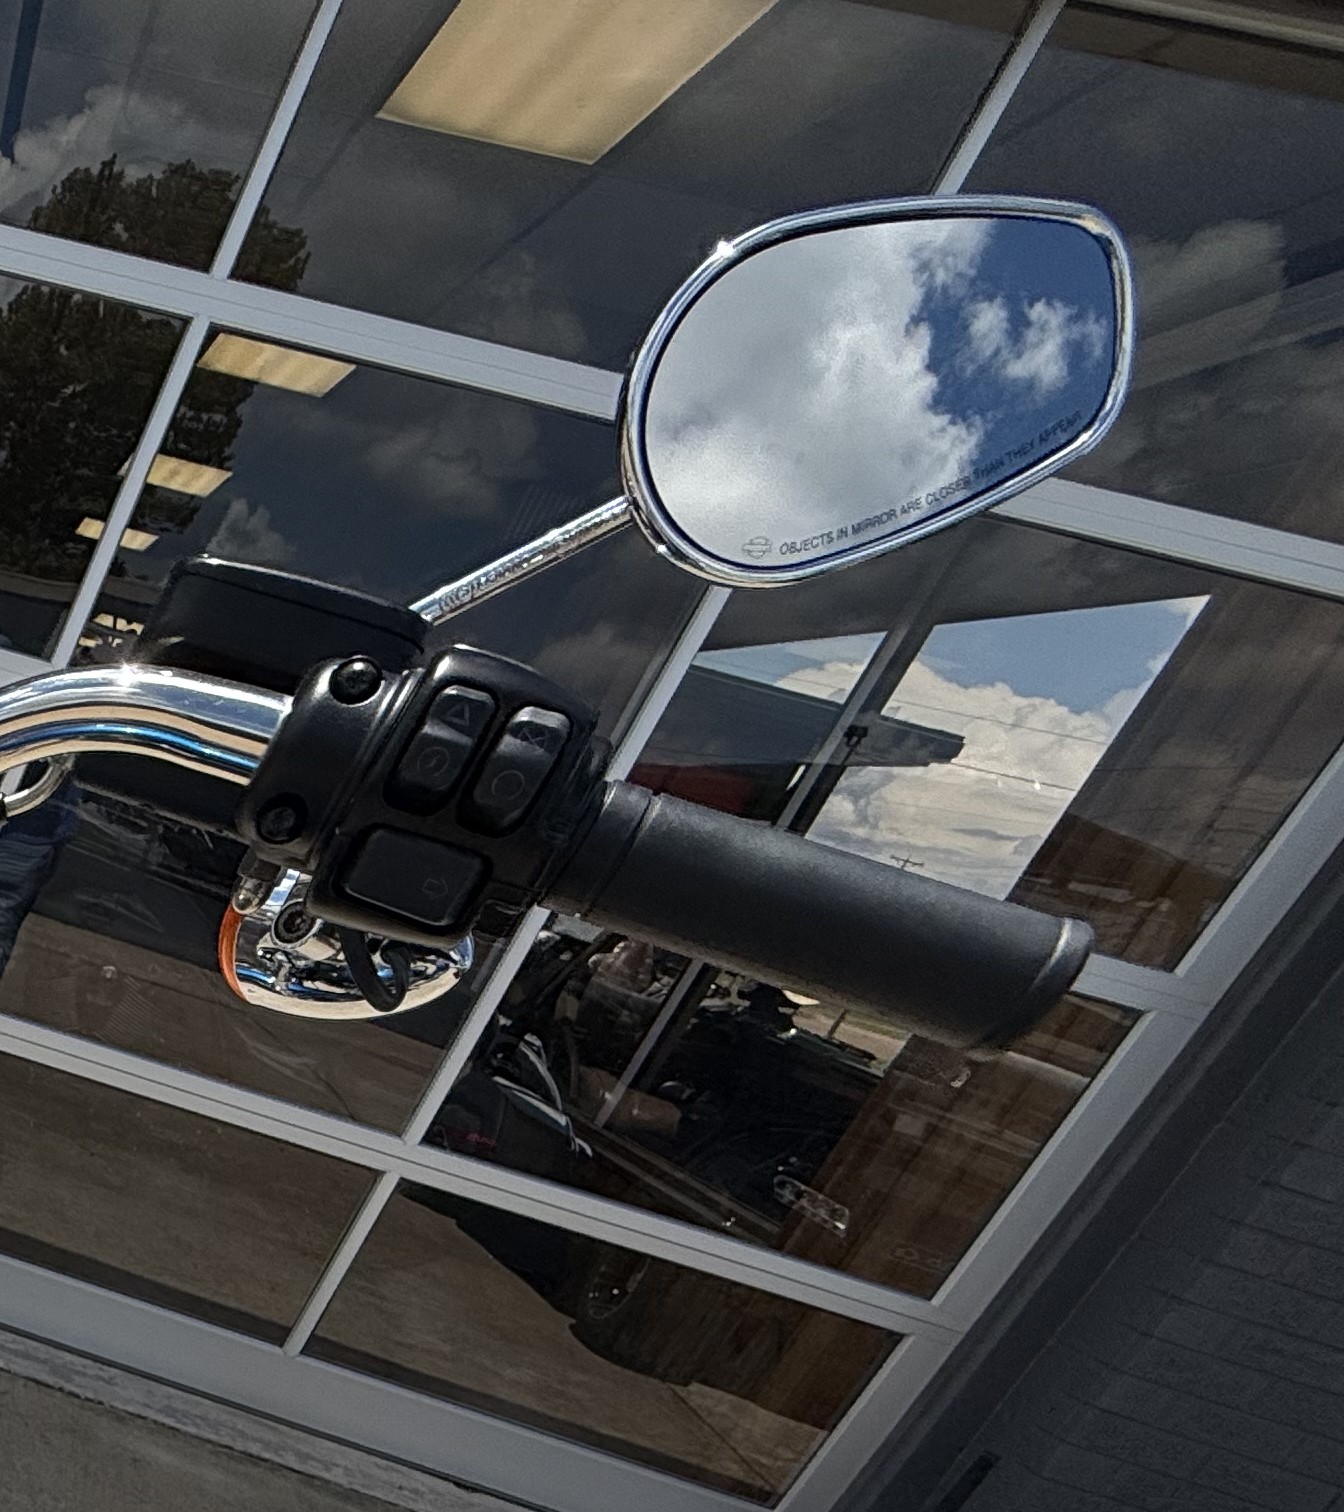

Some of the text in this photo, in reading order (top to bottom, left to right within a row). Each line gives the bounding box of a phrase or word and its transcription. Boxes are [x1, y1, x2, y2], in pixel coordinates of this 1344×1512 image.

[779, 530, 834, 556] OBJECTS
[836, 526, 849, 541] IN
[851, 508, 898, 536] MIRROR
[900, 497, 923, 517] ARE
[925, 475, 972, 506] CLOSER
[973, 457, 1005, 480] THAN
[1005, 438, 1035, 461] THEY
